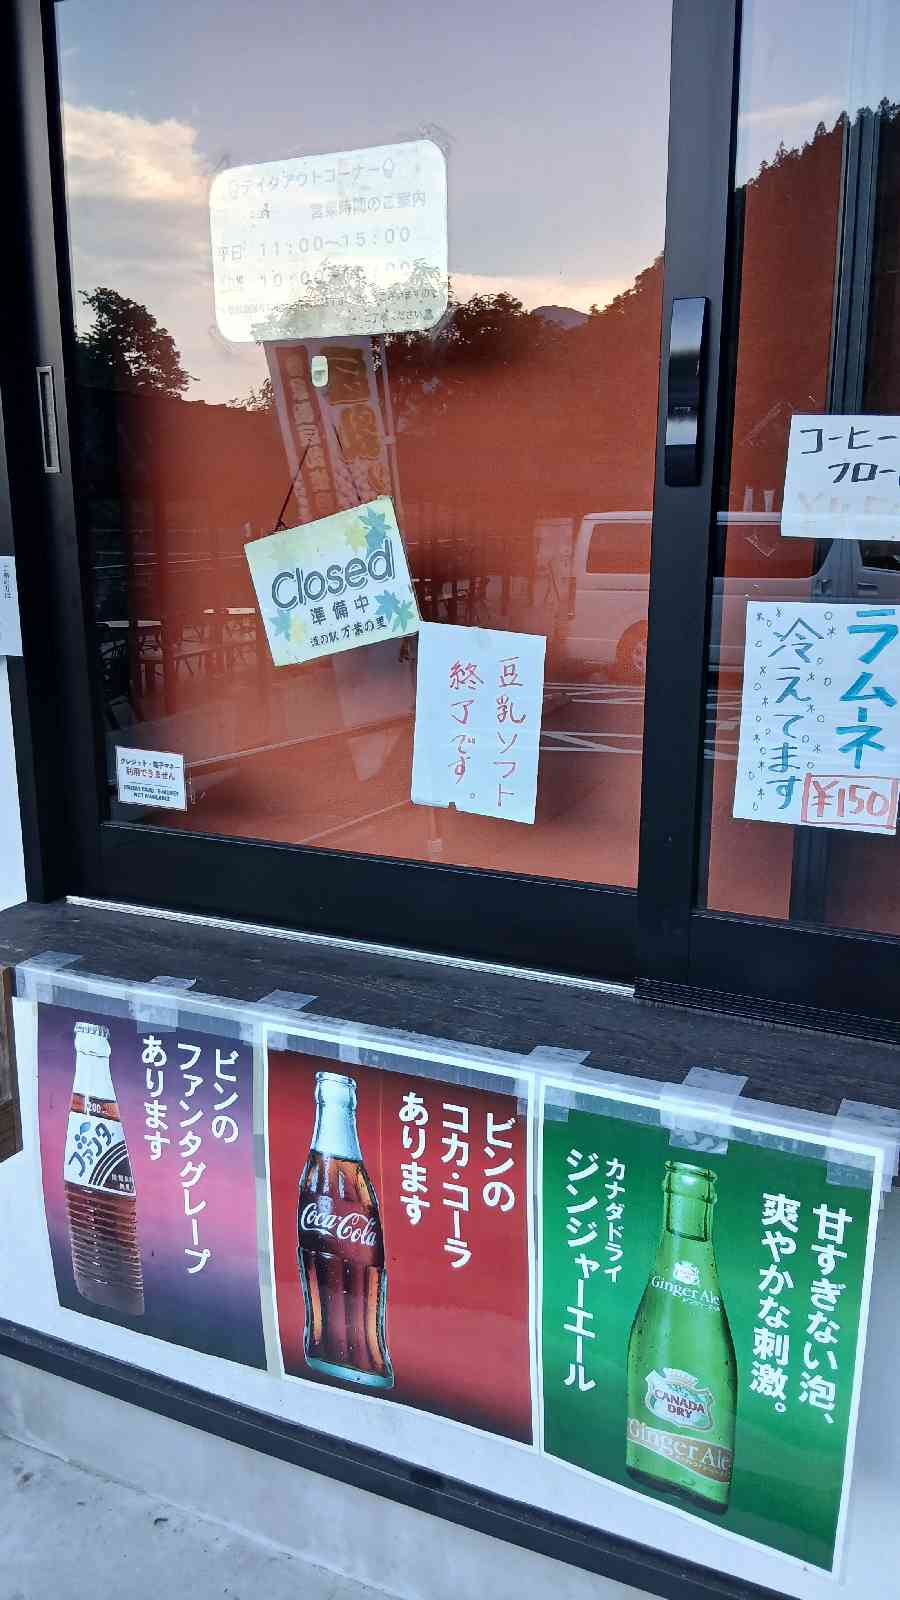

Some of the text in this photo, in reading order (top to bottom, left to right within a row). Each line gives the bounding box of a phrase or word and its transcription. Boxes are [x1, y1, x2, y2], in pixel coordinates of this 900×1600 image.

[799, 426, 898, 455] コーヒー
[828, 462, 900, 488] フロー
[271, 537, 395, 609] Closed
[309, 594, 369, 626] 準備中
[448, 660, 485, 800] 終了です。
[493, 656, 527, 808] 豆乳ソフト
[766, 616, 825, 810] 冷えてます
[834, 608, 898, 770] ラムネ
[811, 780, 889, 818] ¥150
[141, 1035, 170, 1160] あります
[211, 1047, 240, 1144] ビンの
[69, 1122, 112, 1178] ファンタ
[177, 1042, 211, 1274] ファンタグレープ
[399, 1091, 431, 1225] あります
[441, 1102, 472, 1269] コカ・コーラ
[482, 1112, 517, 1212] ビンの
[301, 1202, 377, 1247] Coca-Cola
[563, 1148, 600, 1392] ジンジャーエール
[604, 1157, 626, 1284] カナダドライ
[651, 1275, 700, 1298] Ginger
[701, 1288, 721, 1307] Ale
[749, 1192, 801, 1414] 爽やかな刺激。
[798, 1203, 853, 1425] 甘すぎない泡、
[628, 1418, 698, 1460] Ginger
[702, 1446, 733, 1471] Ale
[653, 1388, 706, 1415] CANADA
[666, 1403, 693, 1419] DRY
